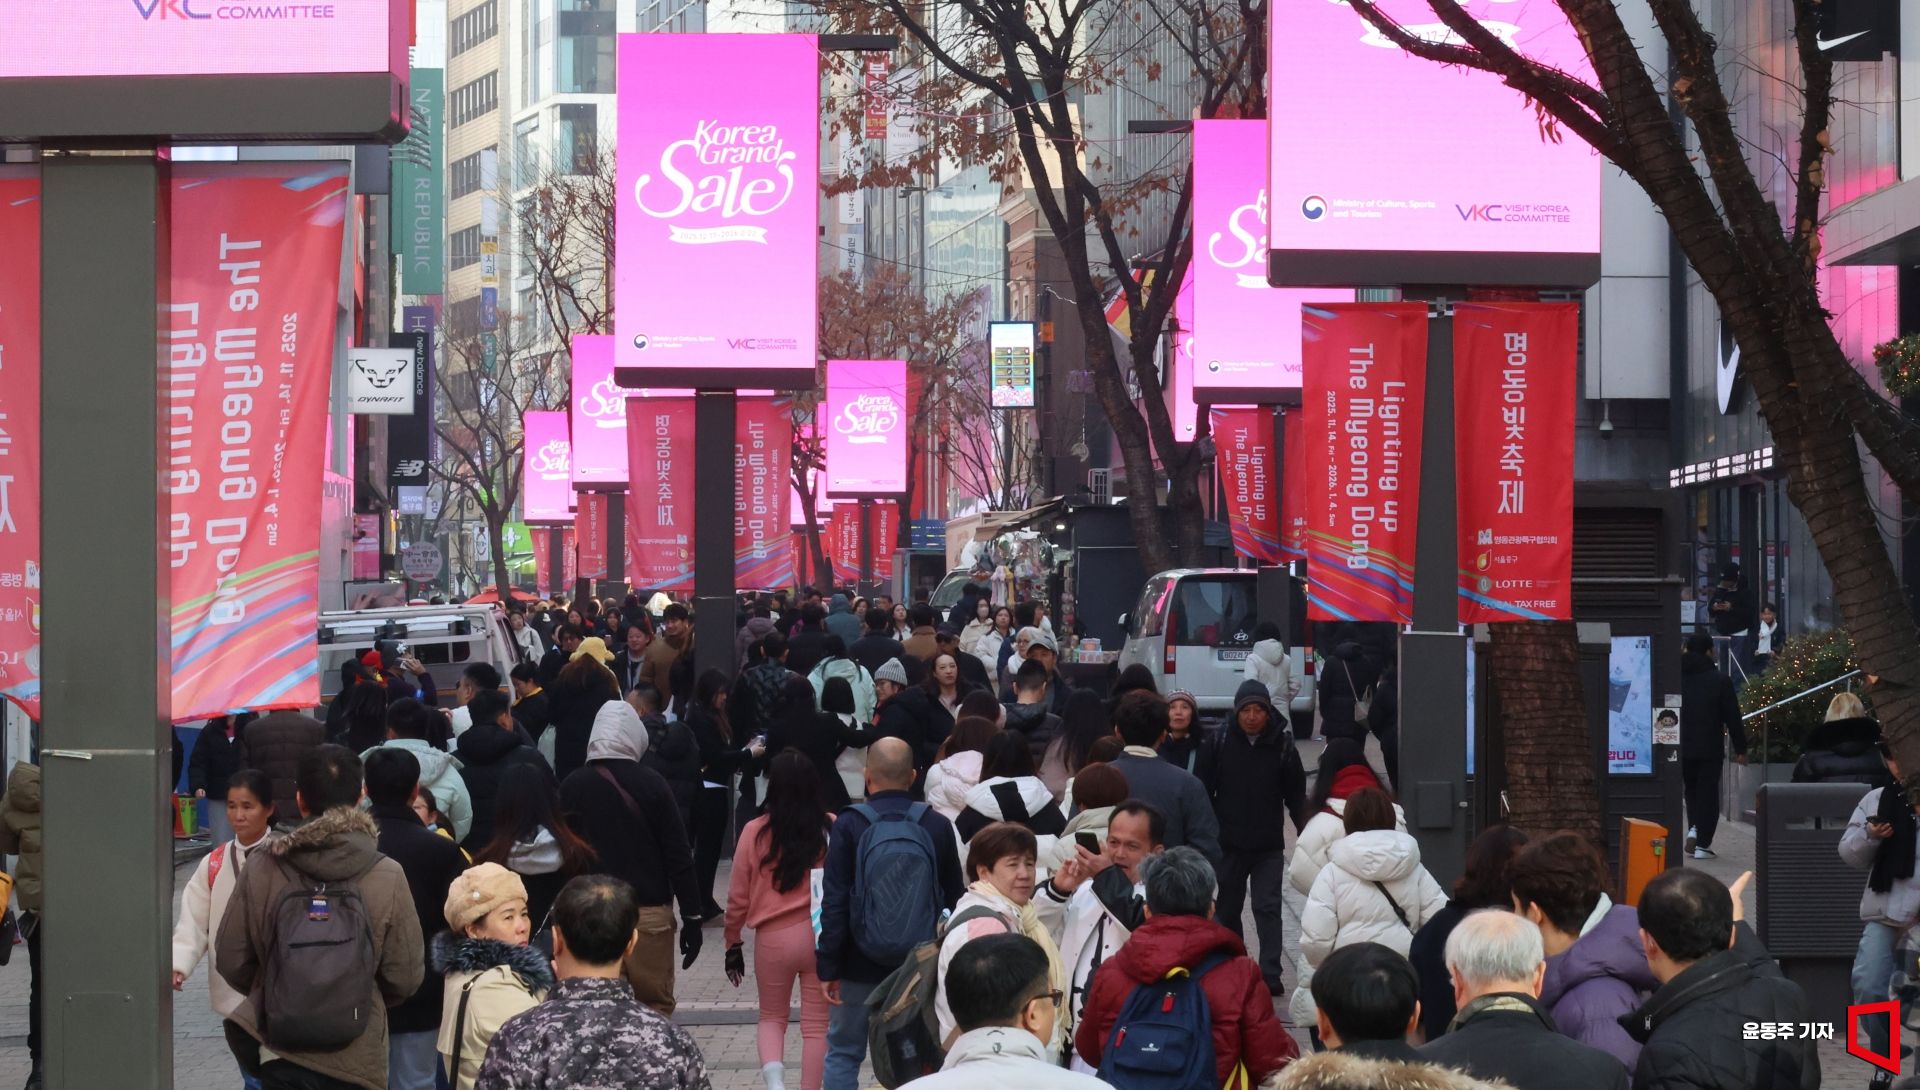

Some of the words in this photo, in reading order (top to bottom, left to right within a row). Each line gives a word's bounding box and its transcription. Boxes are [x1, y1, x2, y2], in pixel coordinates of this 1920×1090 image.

[217, 6, 334, 19] COMMITTEE
[694, 119, 777, 147] Korea
[699, 139, 783, 165] Grand
[635, 140, 797, 218] Sale
[1333, 200, 1365, 209] Ministry
[1367, 200, 1375, 208] of
[1409, 200, 1436, 209] Sports
[1333, 210, 1349, 218] and
[1350, 210, 1382, 218] Tourism
[1455, 204, 1502, 222] VKC
[1505, 205, 1531, 213] VISIT
[1533, 205, 1570, 213] KOREA
[414, 178, 431, 273] REPUBLIC
[1505, 214, 1570, 223] COMMITTEE
[416, 336, 424, 355] new
[727, 339, 756, 350] VKC
[416, 356, 425, 396] balance
[1349, 343, 1374, 390] The
[1327, 390, 1336, 416] 2025.
[834, 402, 898, 434] Sale
[1235, 427, 1248, 450] The
[1345, 398, 1374, 497] Myeong
[1235, 453, 1248, 503] Myeong
[1328, 464, 1338, 491] 2026.
[1256, 504, 1266, 521] up
[1379, 500, 1398, 532] up
[1347, 506, 1375, 569] Dong
[1495, 580, 1532, 588] LOTTE
[1515, 600, 1532, 608] TAX
